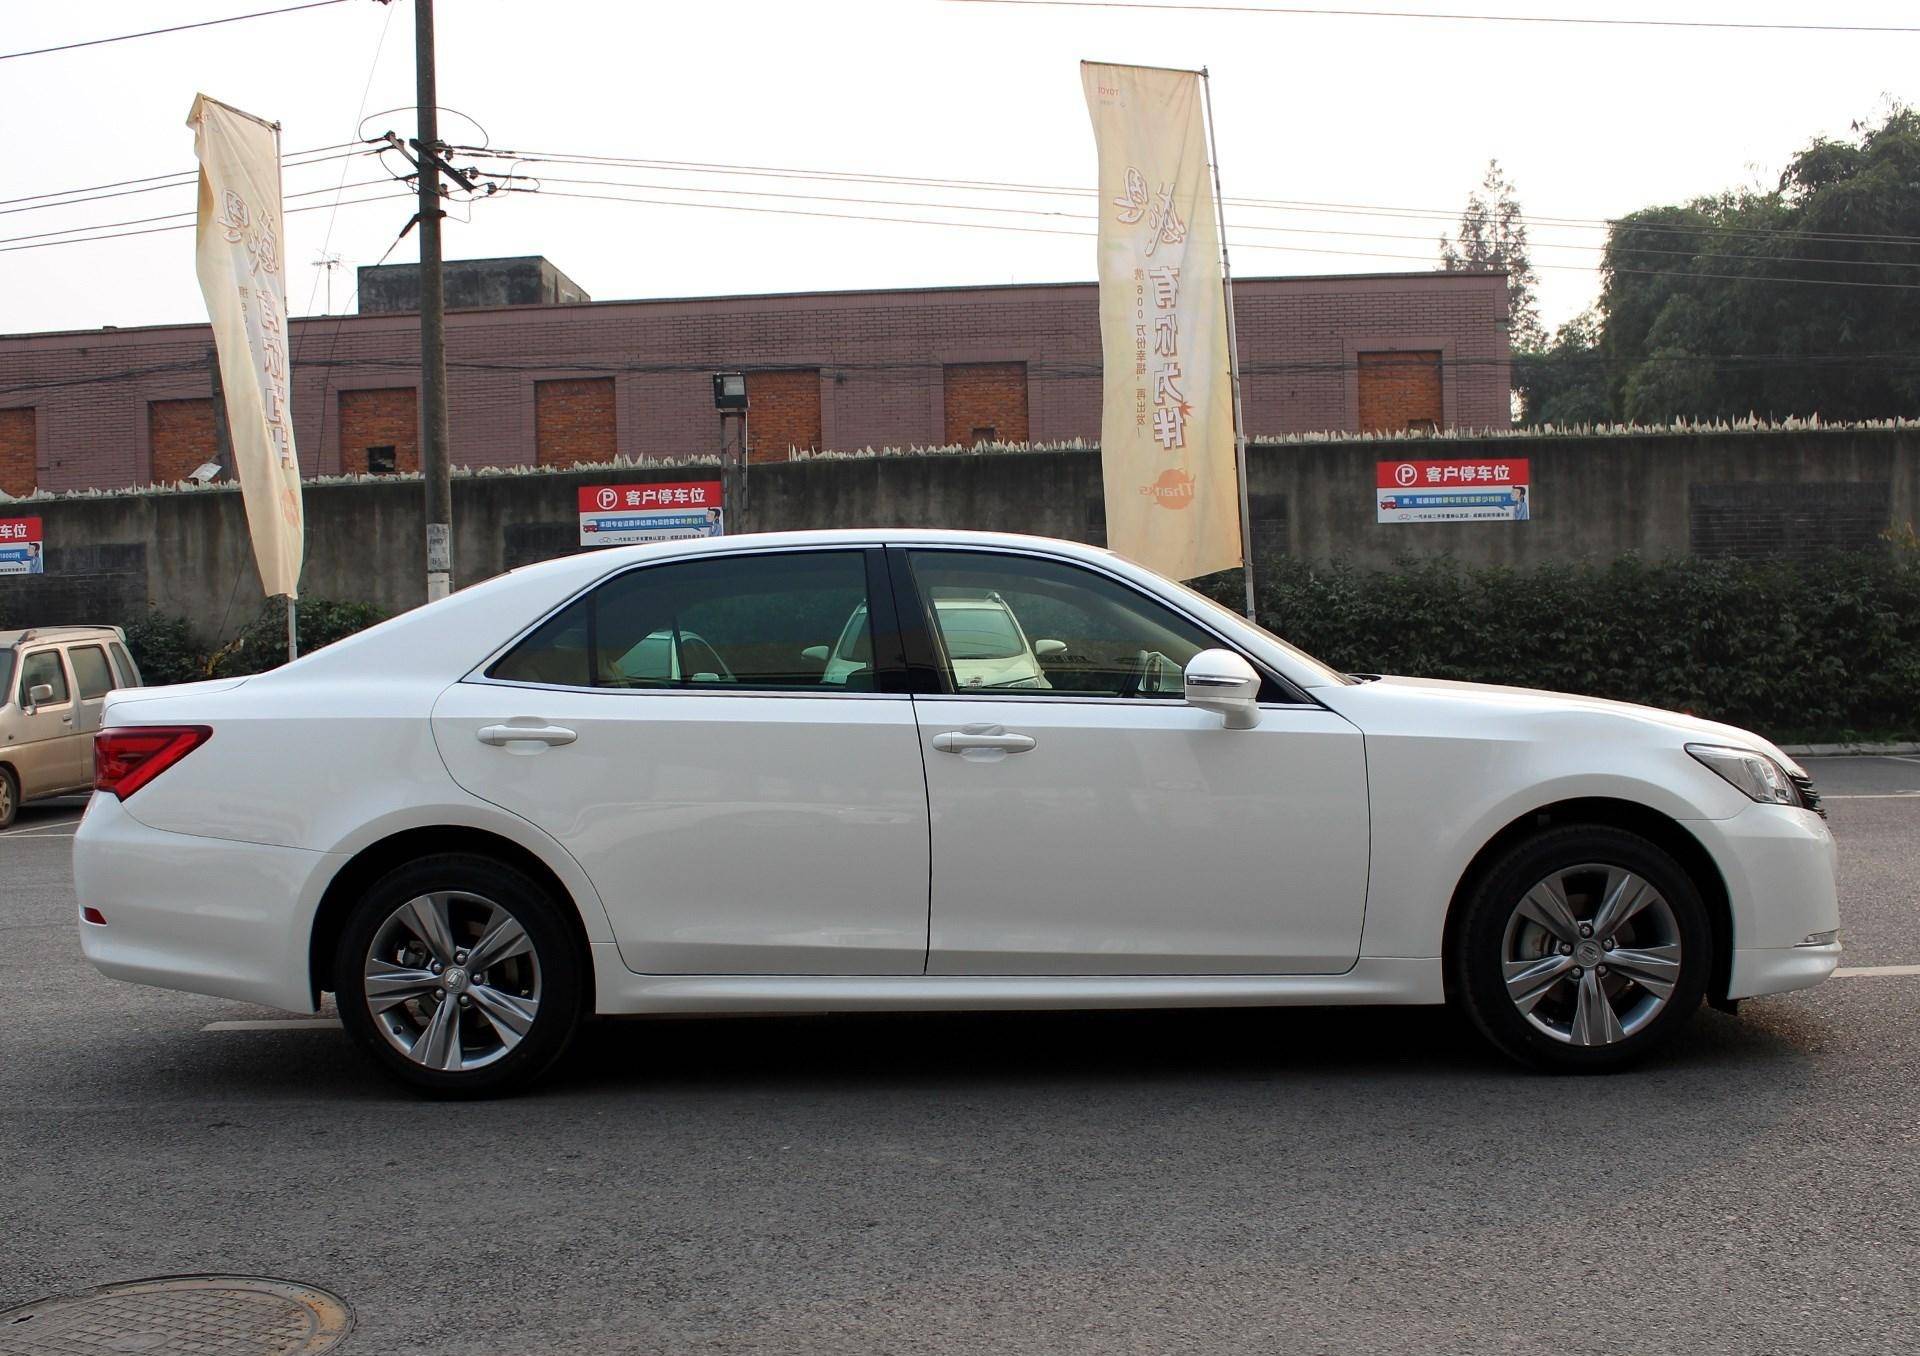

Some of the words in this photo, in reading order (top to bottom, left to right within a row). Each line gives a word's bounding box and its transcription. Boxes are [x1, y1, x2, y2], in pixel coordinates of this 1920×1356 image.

[1426, 464, 1510, 482] 客户停车位
[625, 487, 706, 506] 客户停车位
